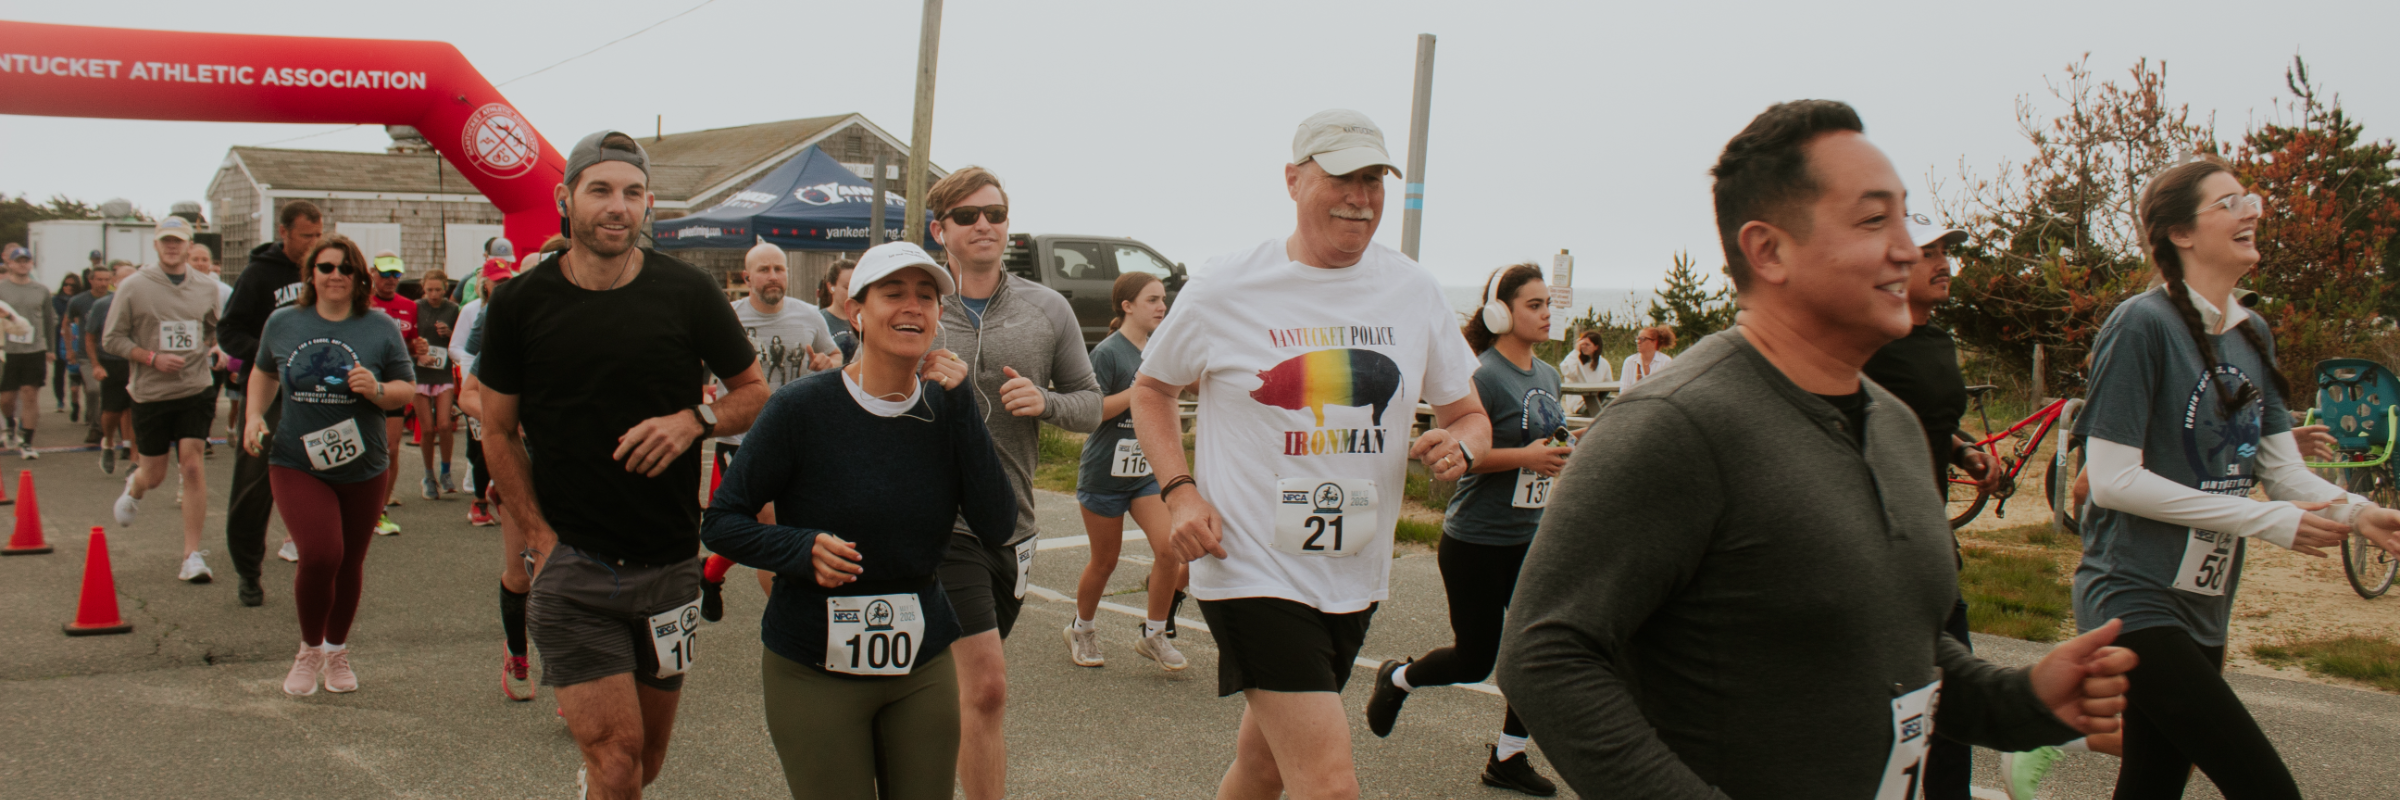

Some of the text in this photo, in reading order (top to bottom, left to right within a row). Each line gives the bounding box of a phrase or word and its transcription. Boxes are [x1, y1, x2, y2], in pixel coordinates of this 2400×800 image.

[129, 60, 254, 85] ATHLETIC
[261, 67, 426, 90] ASSOCIATION
[844, 195, 905, 206] TIMNG
[166, 334, 193, 348] 126
[1269, 325, 1396, 348] NANTUCKET POLICE
[318, 438, 357, 465] 125
[1284, 428, 1387, 456] IRONMAN
[1122, 457, 1147, 473] 116
[1350, 497, 1369, 507] 2025
[1302, 515, 1343, 550] 21
[2195, 554, 2227, 590] 58
[900, 612, 916, 622] 2025
[846, 631, 911, 669] 100
